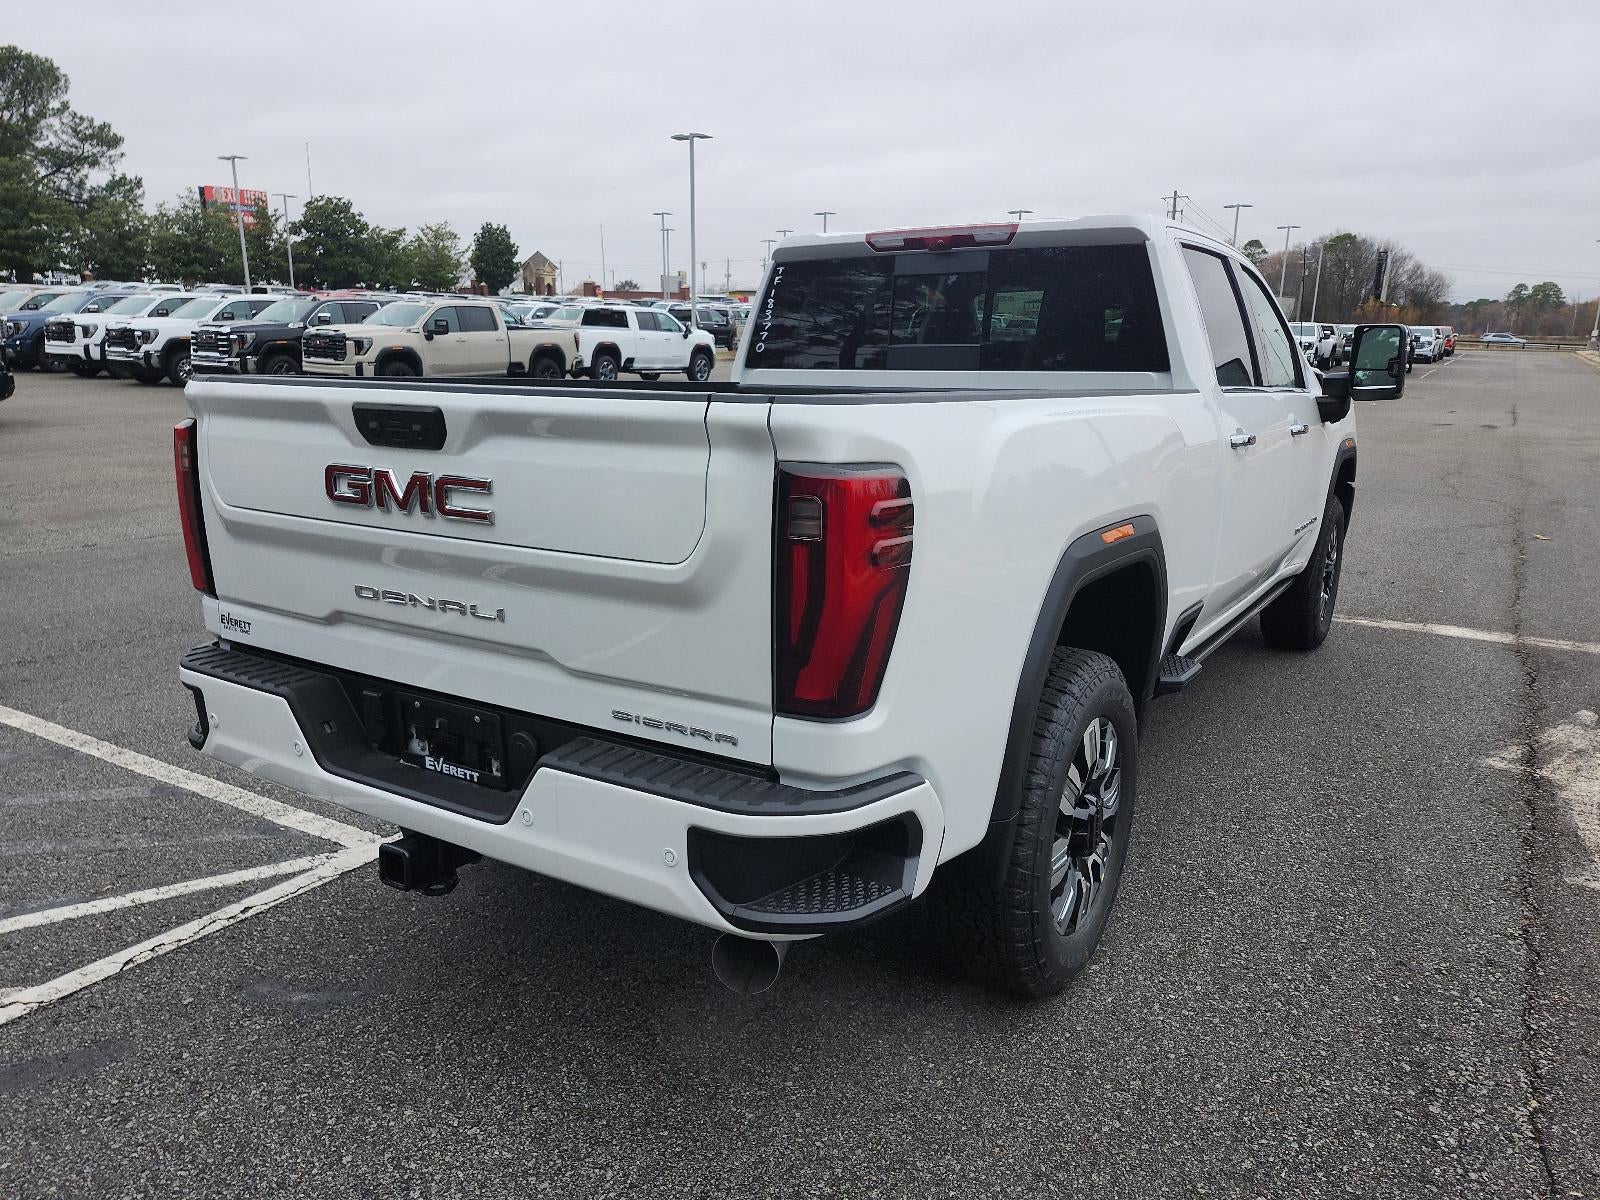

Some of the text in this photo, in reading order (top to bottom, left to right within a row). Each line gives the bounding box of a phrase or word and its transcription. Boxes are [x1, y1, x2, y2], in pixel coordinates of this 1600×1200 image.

[756, 266, 786, 352] TF183770
[324, 462, 496, 526] GMC
[220, 612, 251, 630] EVERETT
[354, 583, 506, 623] DENALI
[611, 709, 739, 746] SIERRA
[425, 756, 480, 782] EVERETT
